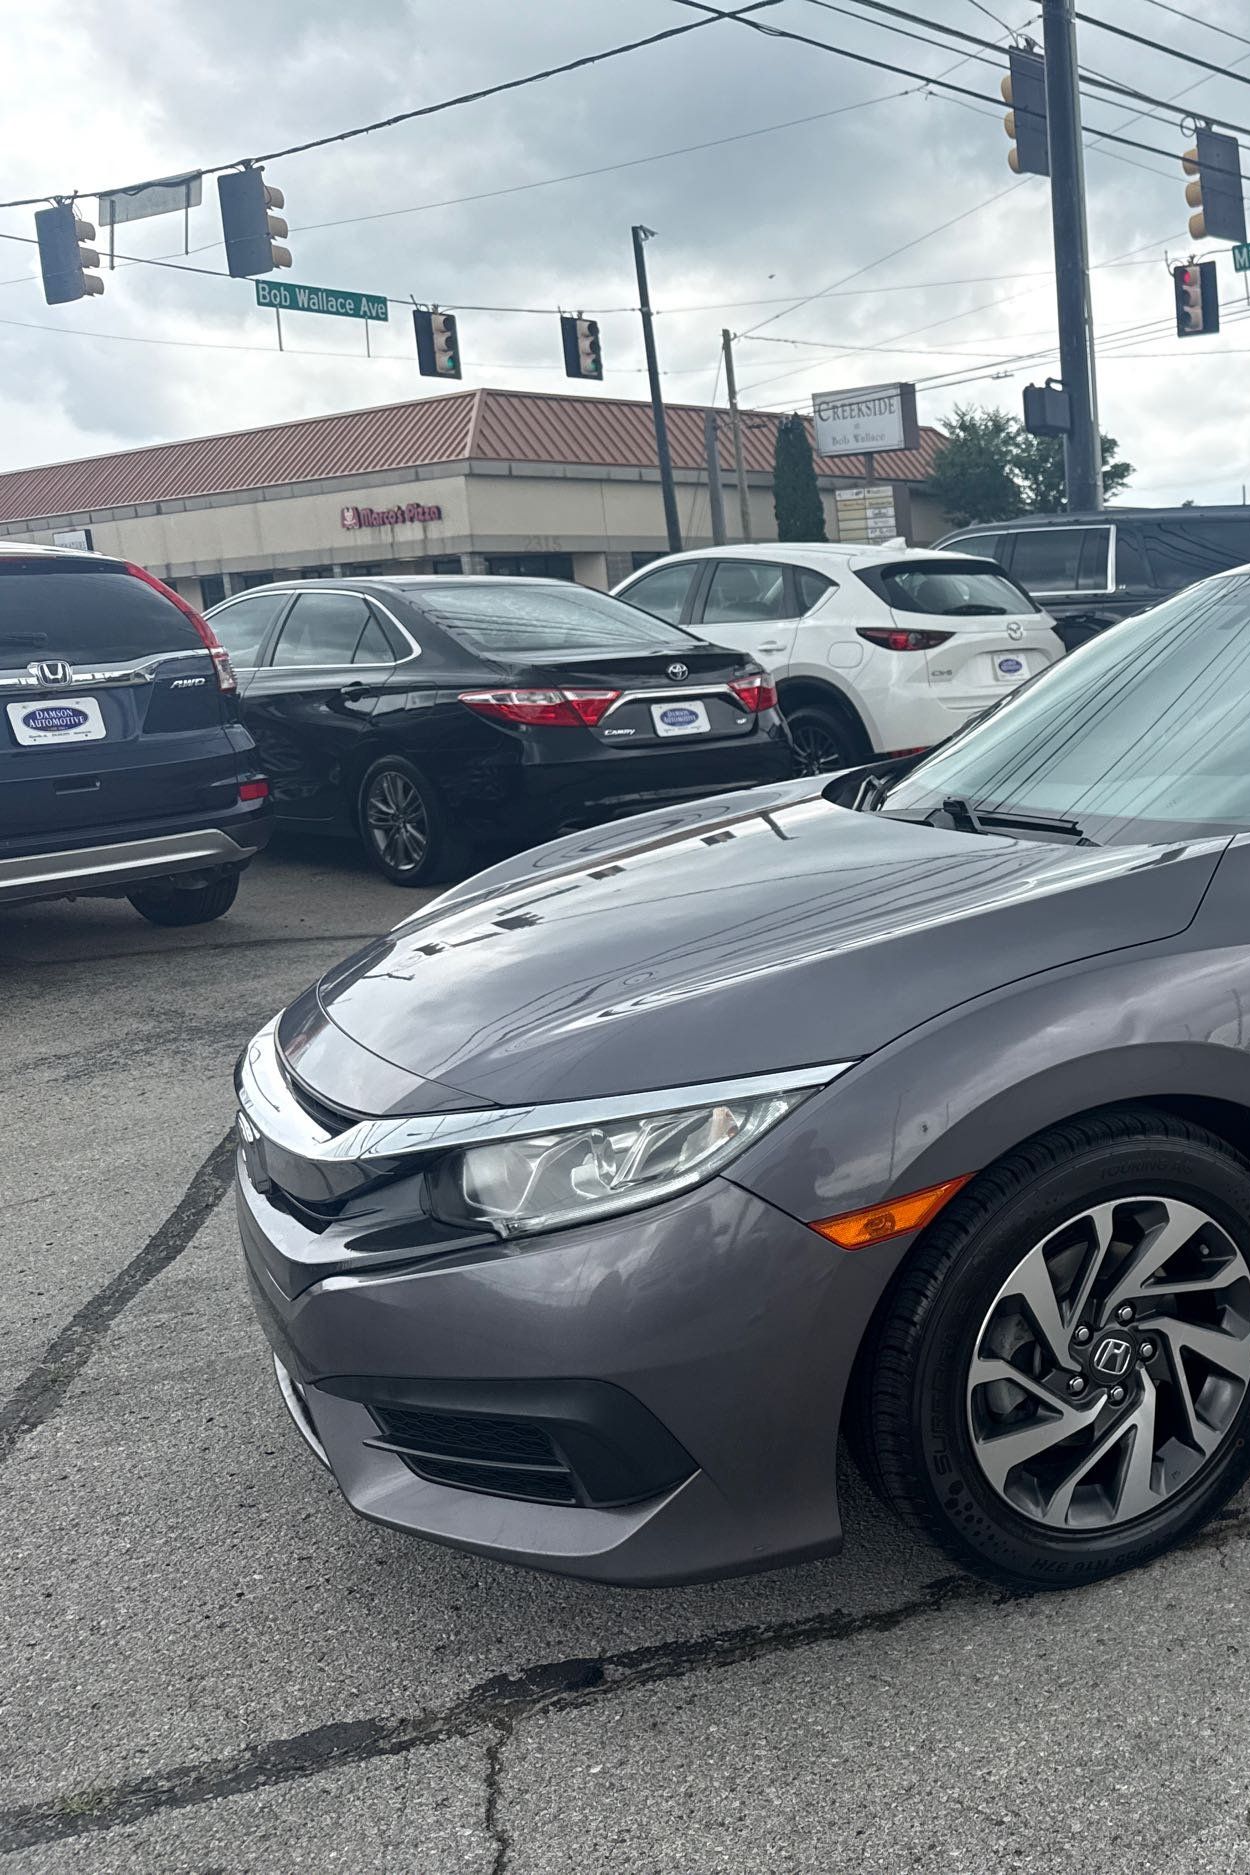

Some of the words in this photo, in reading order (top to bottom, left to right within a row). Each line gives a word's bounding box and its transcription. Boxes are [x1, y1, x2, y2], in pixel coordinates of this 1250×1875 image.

[258, 283, 290, 306] Bob
[295, 287, 354, 313] Wallace
[360, 297, 386, 318] Ave
[818, 399, 896, 422] CREEKSIDE
[832, 435, 850, 447] Bob
[853, 432, 886, 444] Wallace
[361, 506, 405, 528] Marco's
[405, 503, 441, 524] Pizza
[170, 677, 206, 689] AWD
[29, 715, 84, 728] AUTOMOTIVE
[35, 709, 73, 720] DAMSON
